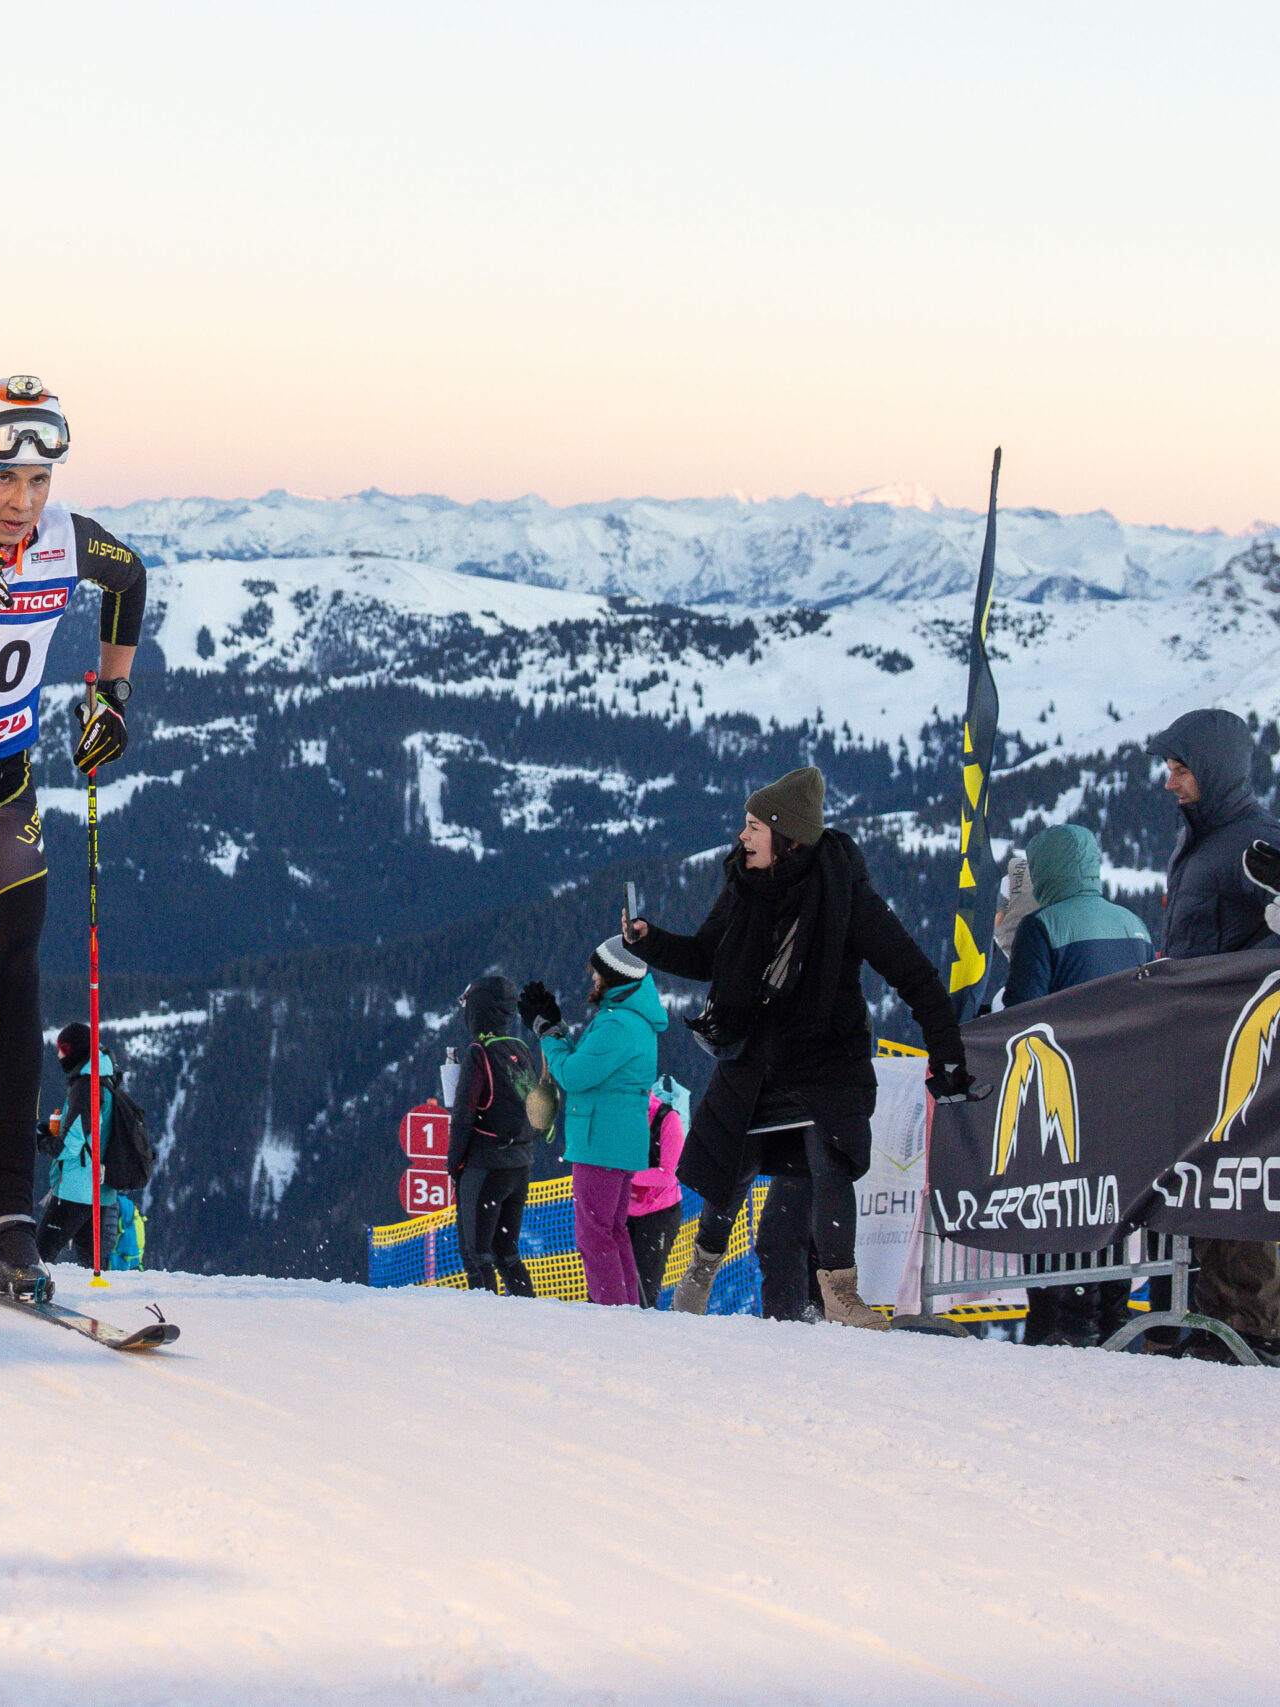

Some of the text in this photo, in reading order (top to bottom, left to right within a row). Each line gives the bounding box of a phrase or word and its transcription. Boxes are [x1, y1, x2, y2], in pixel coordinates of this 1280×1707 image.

[83, 722, 101, 751] CHIBA
[88, 785, 97, 824] LEKI
[422, 1123, 434, 1148] 1
[413, 1178, 445, 1206] 3a
[934, 1174, 1119, 1231] LA SPORTIVA
